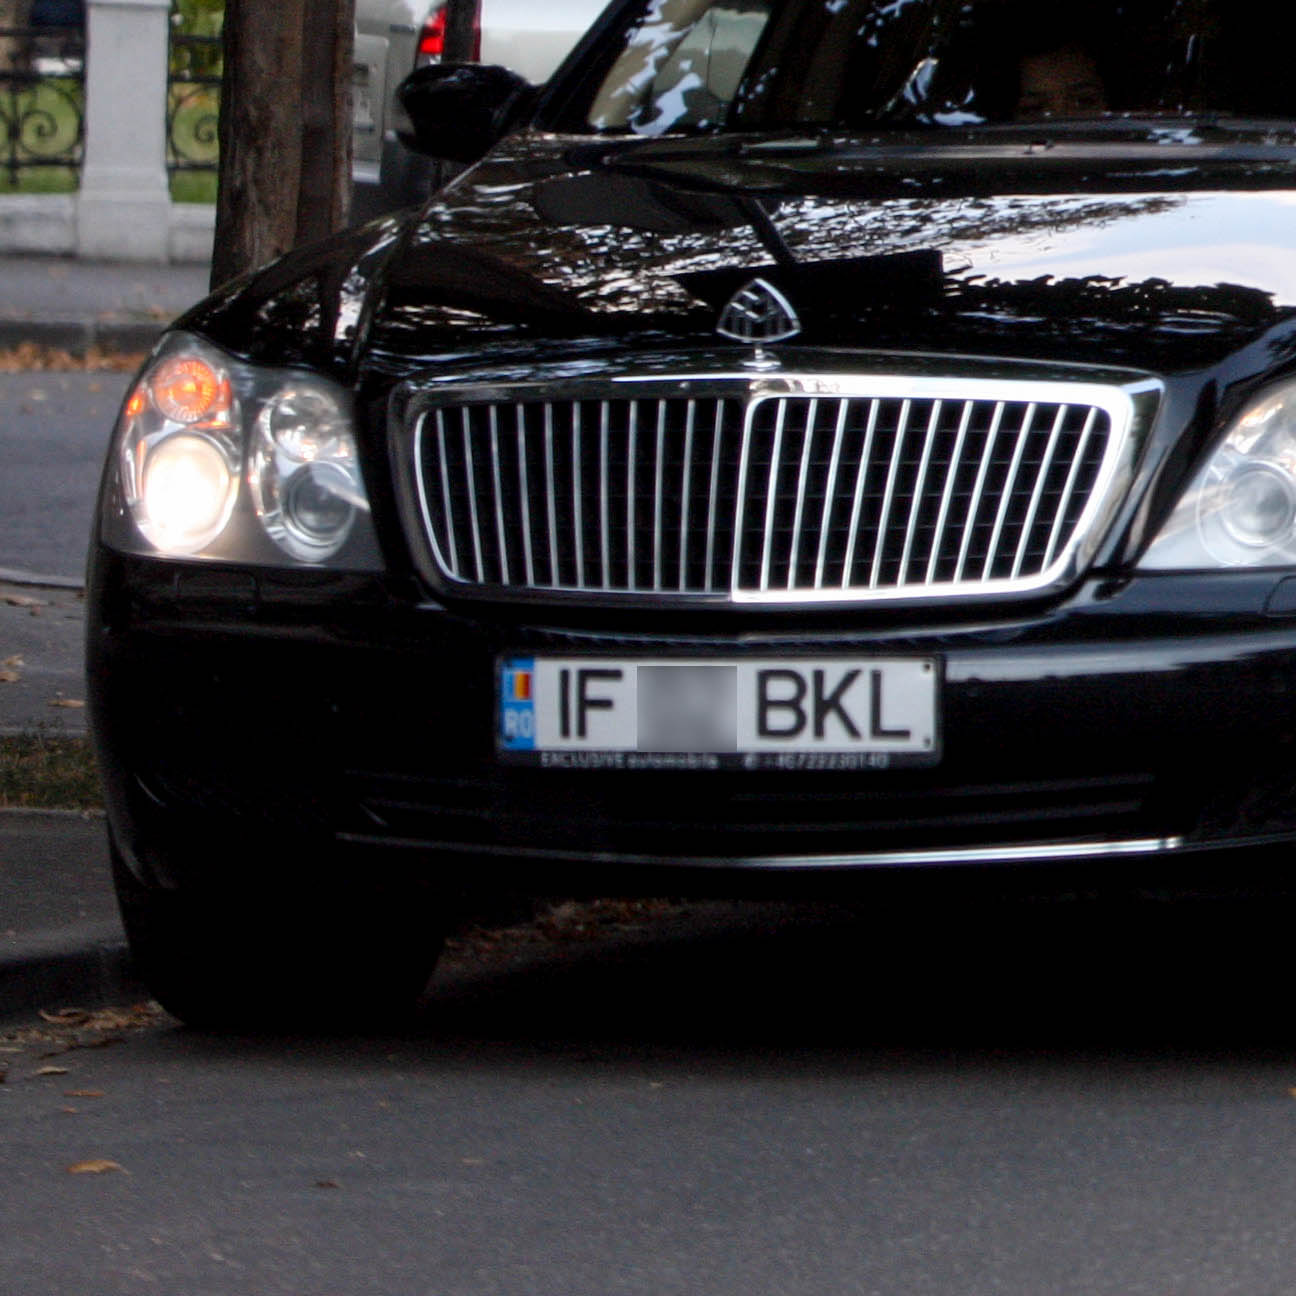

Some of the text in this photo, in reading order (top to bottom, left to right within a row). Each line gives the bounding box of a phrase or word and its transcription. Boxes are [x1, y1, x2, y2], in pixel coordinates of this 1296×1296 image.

[504, 707, 534, 739] RO
[558, 668, 624, 740] IF
[756, 668, 911, 741] BKL
